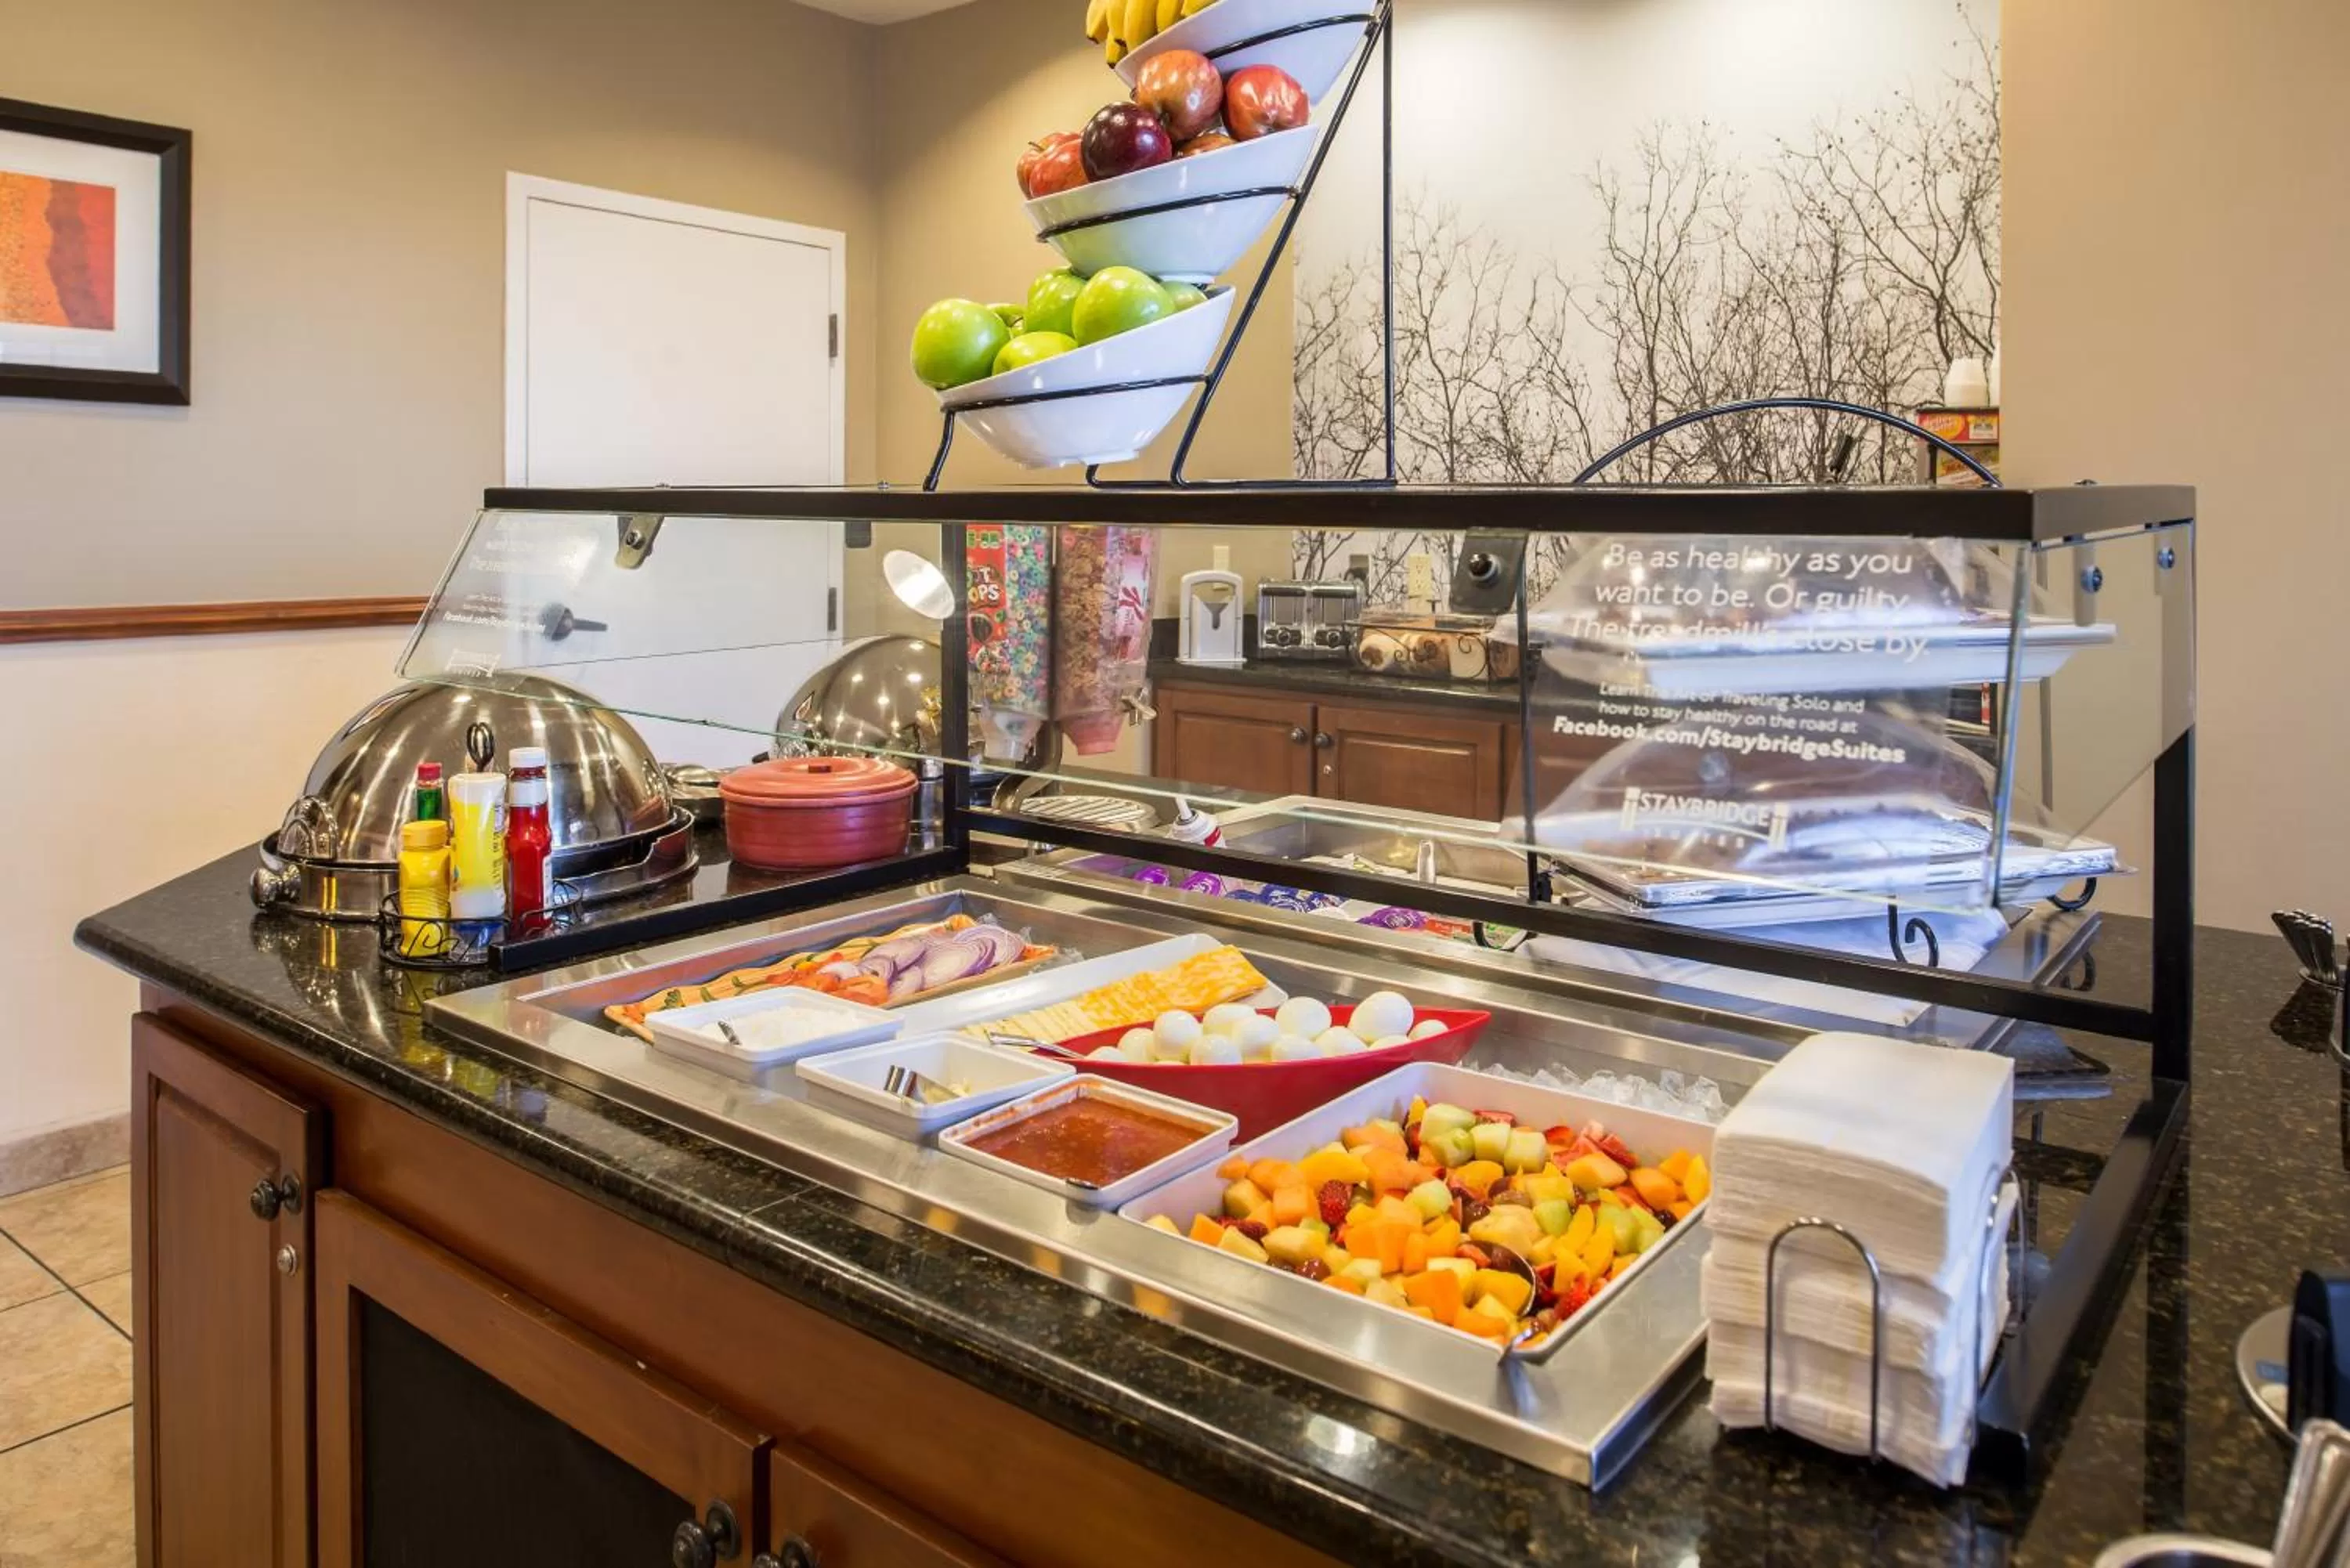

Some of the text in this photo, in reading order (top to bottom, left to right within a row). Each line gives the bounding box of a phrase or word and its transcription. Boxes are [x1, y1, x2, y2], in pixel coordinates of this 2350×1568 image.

[1607, 542, 1643, 568] Be
[1649, 549, 1680, 569] as
[1806, 551, 1841, 572] as
[1845, 553, 1913, 580] you
[1595, 583, 1665, 605] want
[1672, 584, 1703, 606] to
[1711, 583, 1755, 609] be.
[1765, 582, 1810, 609] Or
[1569, 613, 1619, 639] The
[1885, 630, 1931, 663] by.
[1599, 681, 1640, 697] Learn
[1721, 690, 1791, 712] Traveling
[1791, 694, 1831, 711] Solo
[1832, 699, 1866, 714] and
[1598, 700, 1860, 735] how to stay healthy on the road at
[1553, 714, 1907, 764] Facebook.com/StaybridgeSuites
[1637, 792, 1771, 827] STAYBRIDGE
